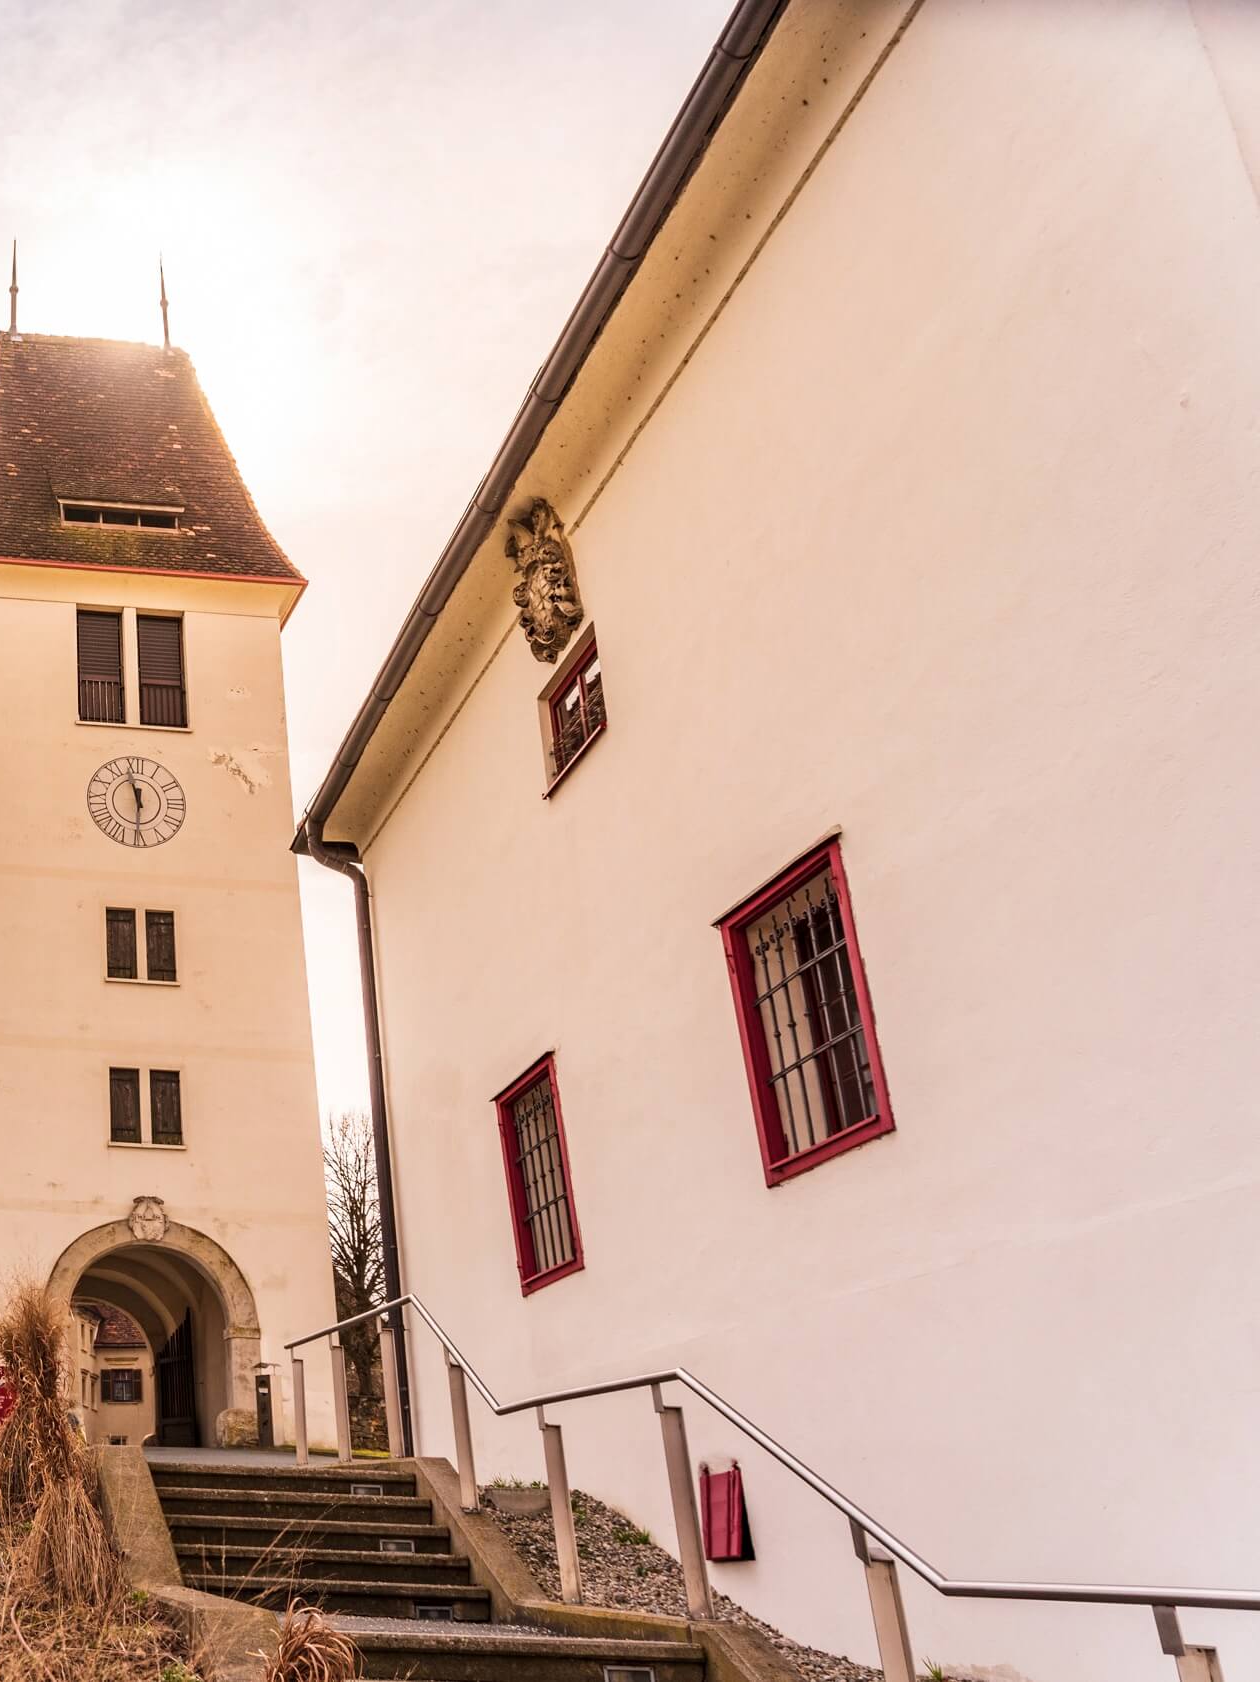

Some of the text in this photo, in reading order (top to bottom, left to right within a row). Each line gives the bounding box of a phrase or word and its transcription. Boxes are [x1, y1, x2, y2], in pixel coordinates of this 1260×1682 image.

[104, 761, 124, 781] XI
[126, 758, 144, 775] XII
[150, 765, 161, 779] I
[93, 775, 111, 790] X
[161, 780, 179, 792] II
[89, 790, 106, 805] IX
[167, 798, 185, 811] III
[91, 807, 113, 831] VIII
[108, 821, 125, 843] VII
[153, 826, 167, 843] V
